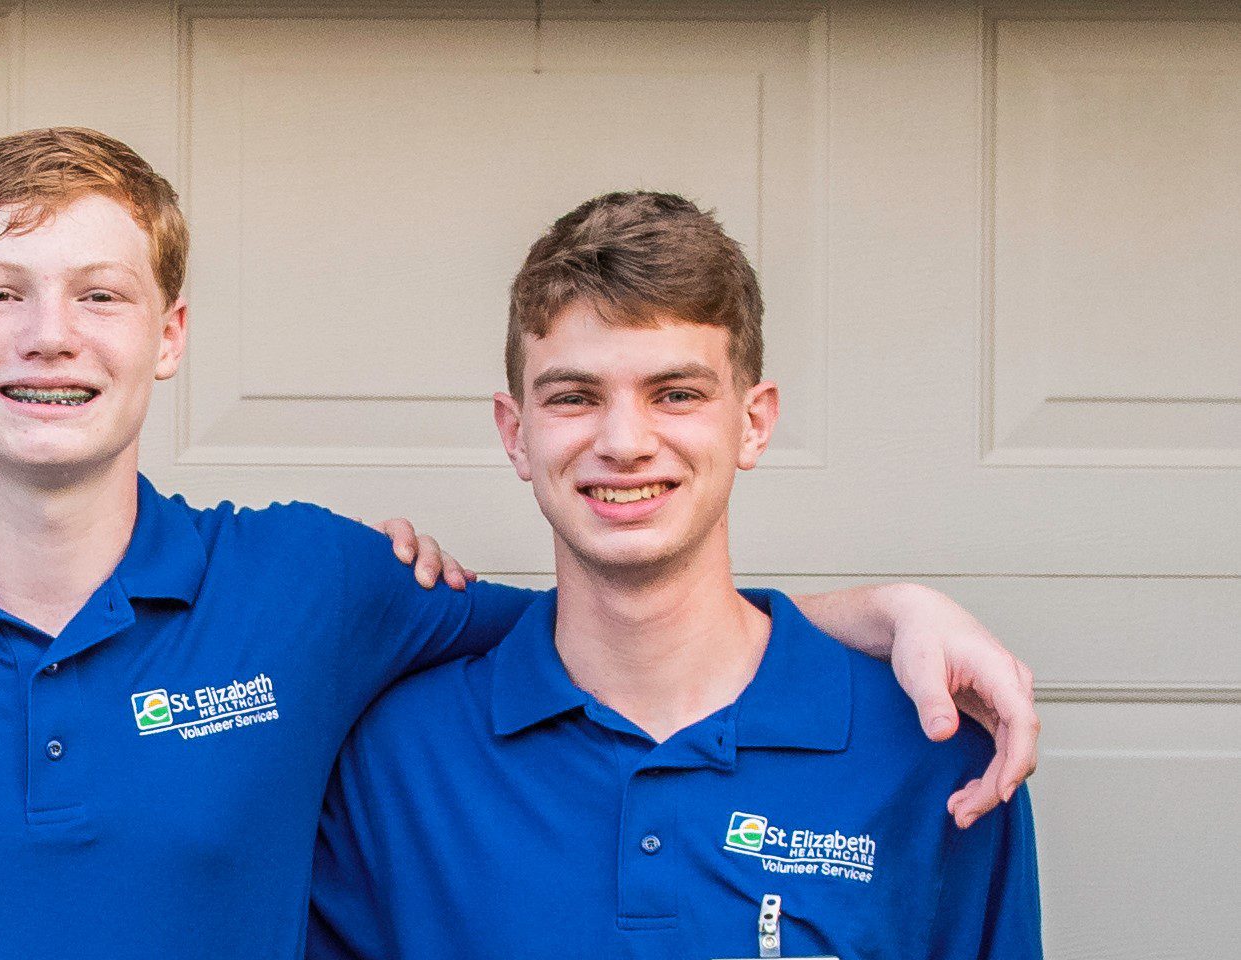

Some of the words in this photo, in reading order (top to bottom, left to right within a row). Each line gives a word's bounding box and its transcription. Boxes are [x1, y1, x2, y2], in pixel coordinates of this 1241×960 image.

[195, 673, 273, 707] Elizabeth
[199, 692, 276, 718] HEALTHCARE
[178, 719, 234, 740] Volunteer
[235, 709, 279, 727] Services
[791, 830, 876, 855] Elizabeth
[789, 848, 875, 866] HEALTHCARE
[762, 858, 818, 874] Volunteer
[820, 862, 873, 883] Services
